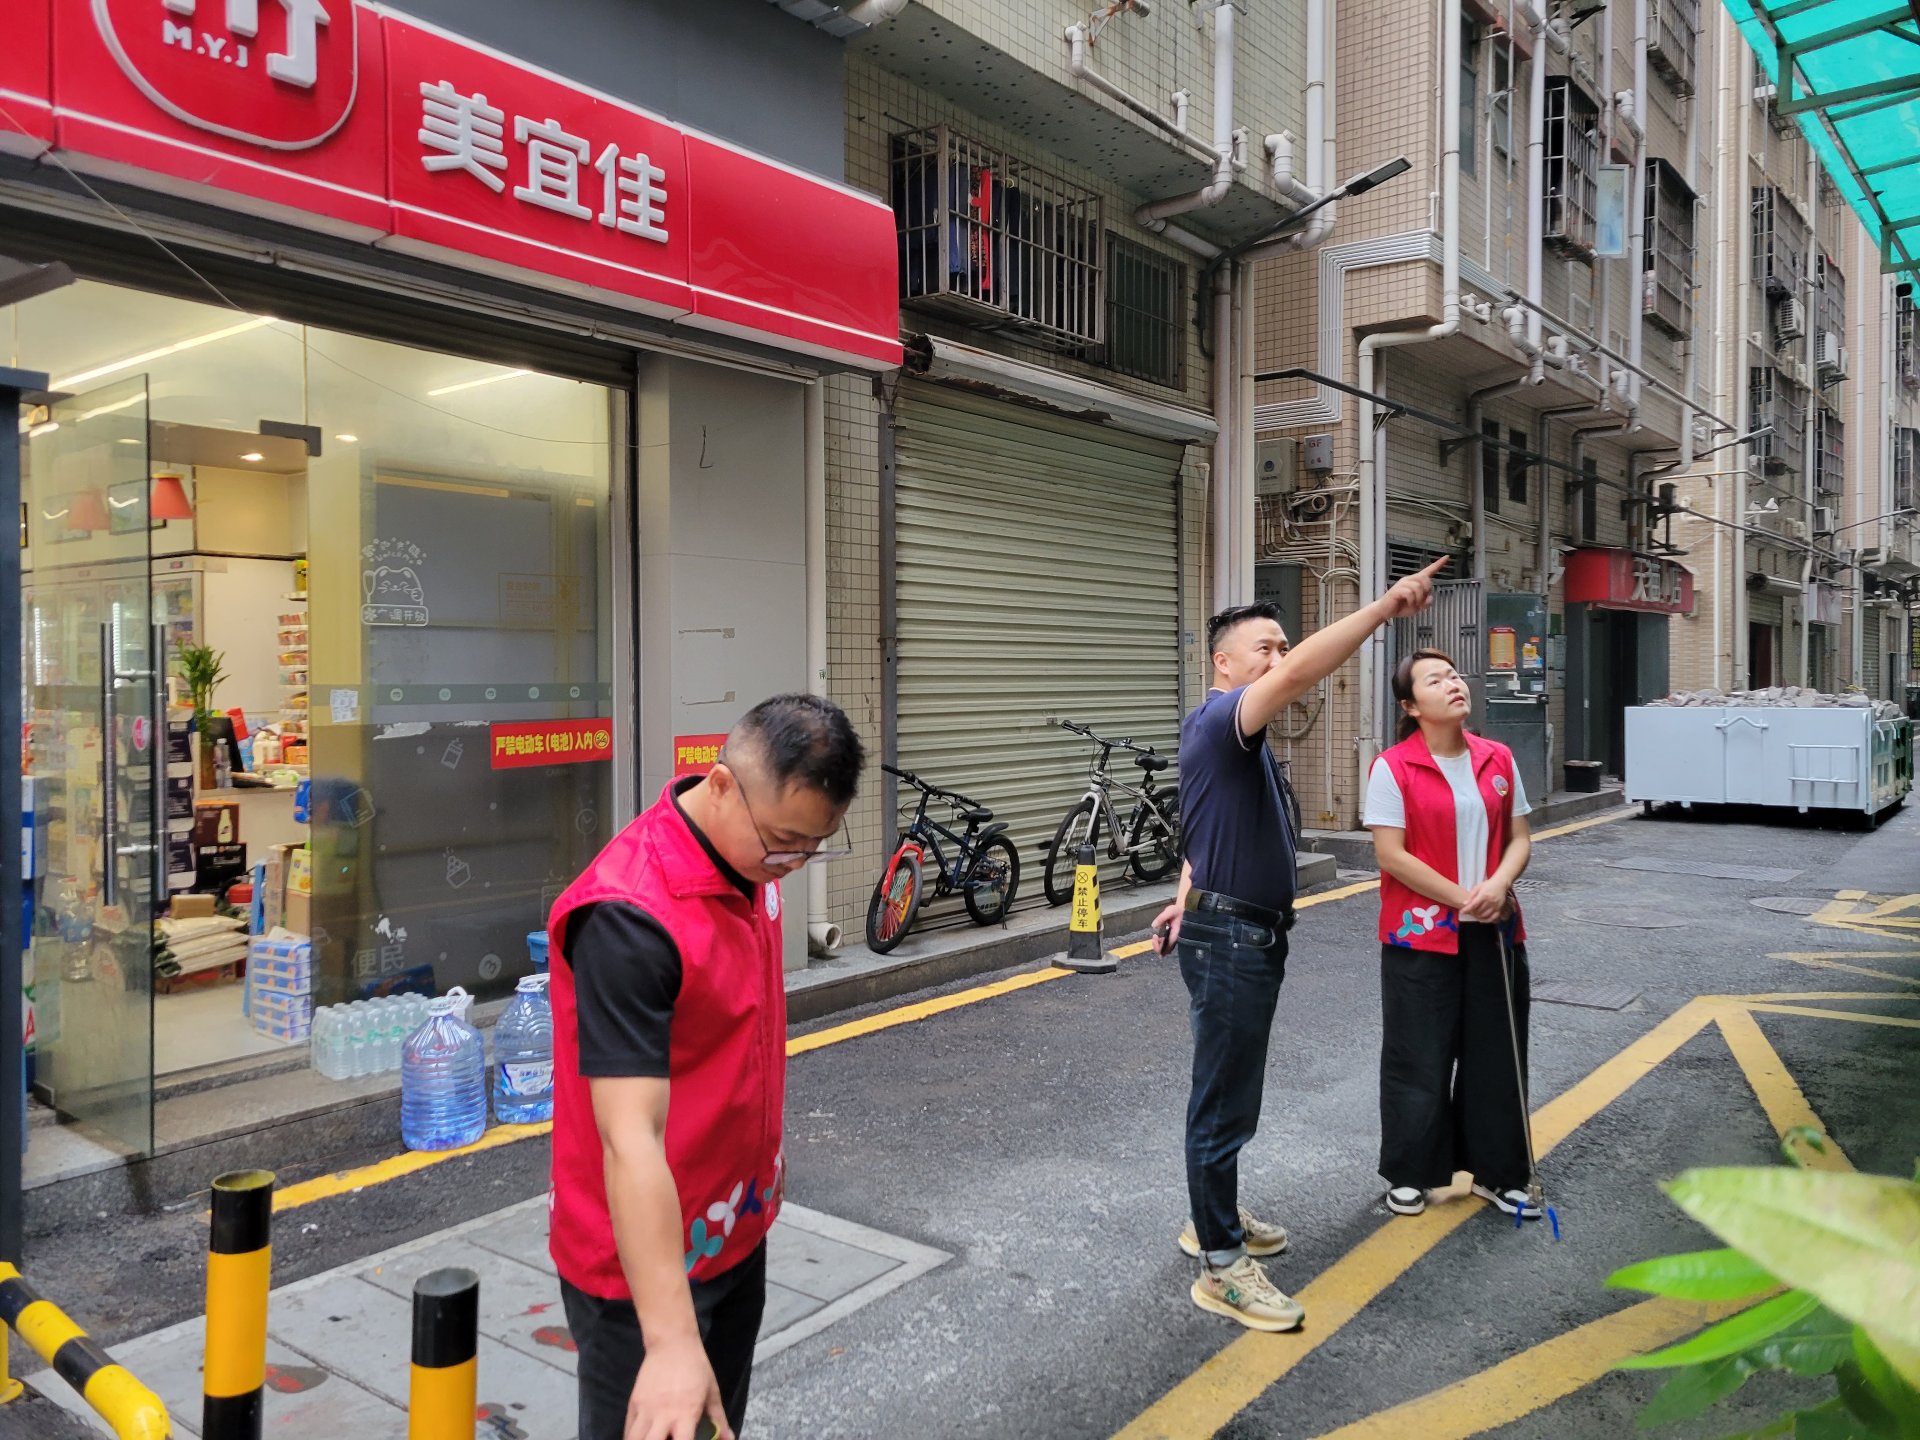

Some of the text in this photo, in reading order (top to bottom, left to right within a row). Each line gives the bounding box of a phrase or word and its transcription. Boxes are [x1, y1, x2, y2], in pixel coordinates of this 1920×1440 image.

[162, 19, 249, 69] M.Y.J
[417, 80, 669, 243] 美宜佳
[677, 744, 725, 766] 严禁电动车
[1077, 887, 1088, 928] 禁止停车
[351, 943, 405, 979] 便民
